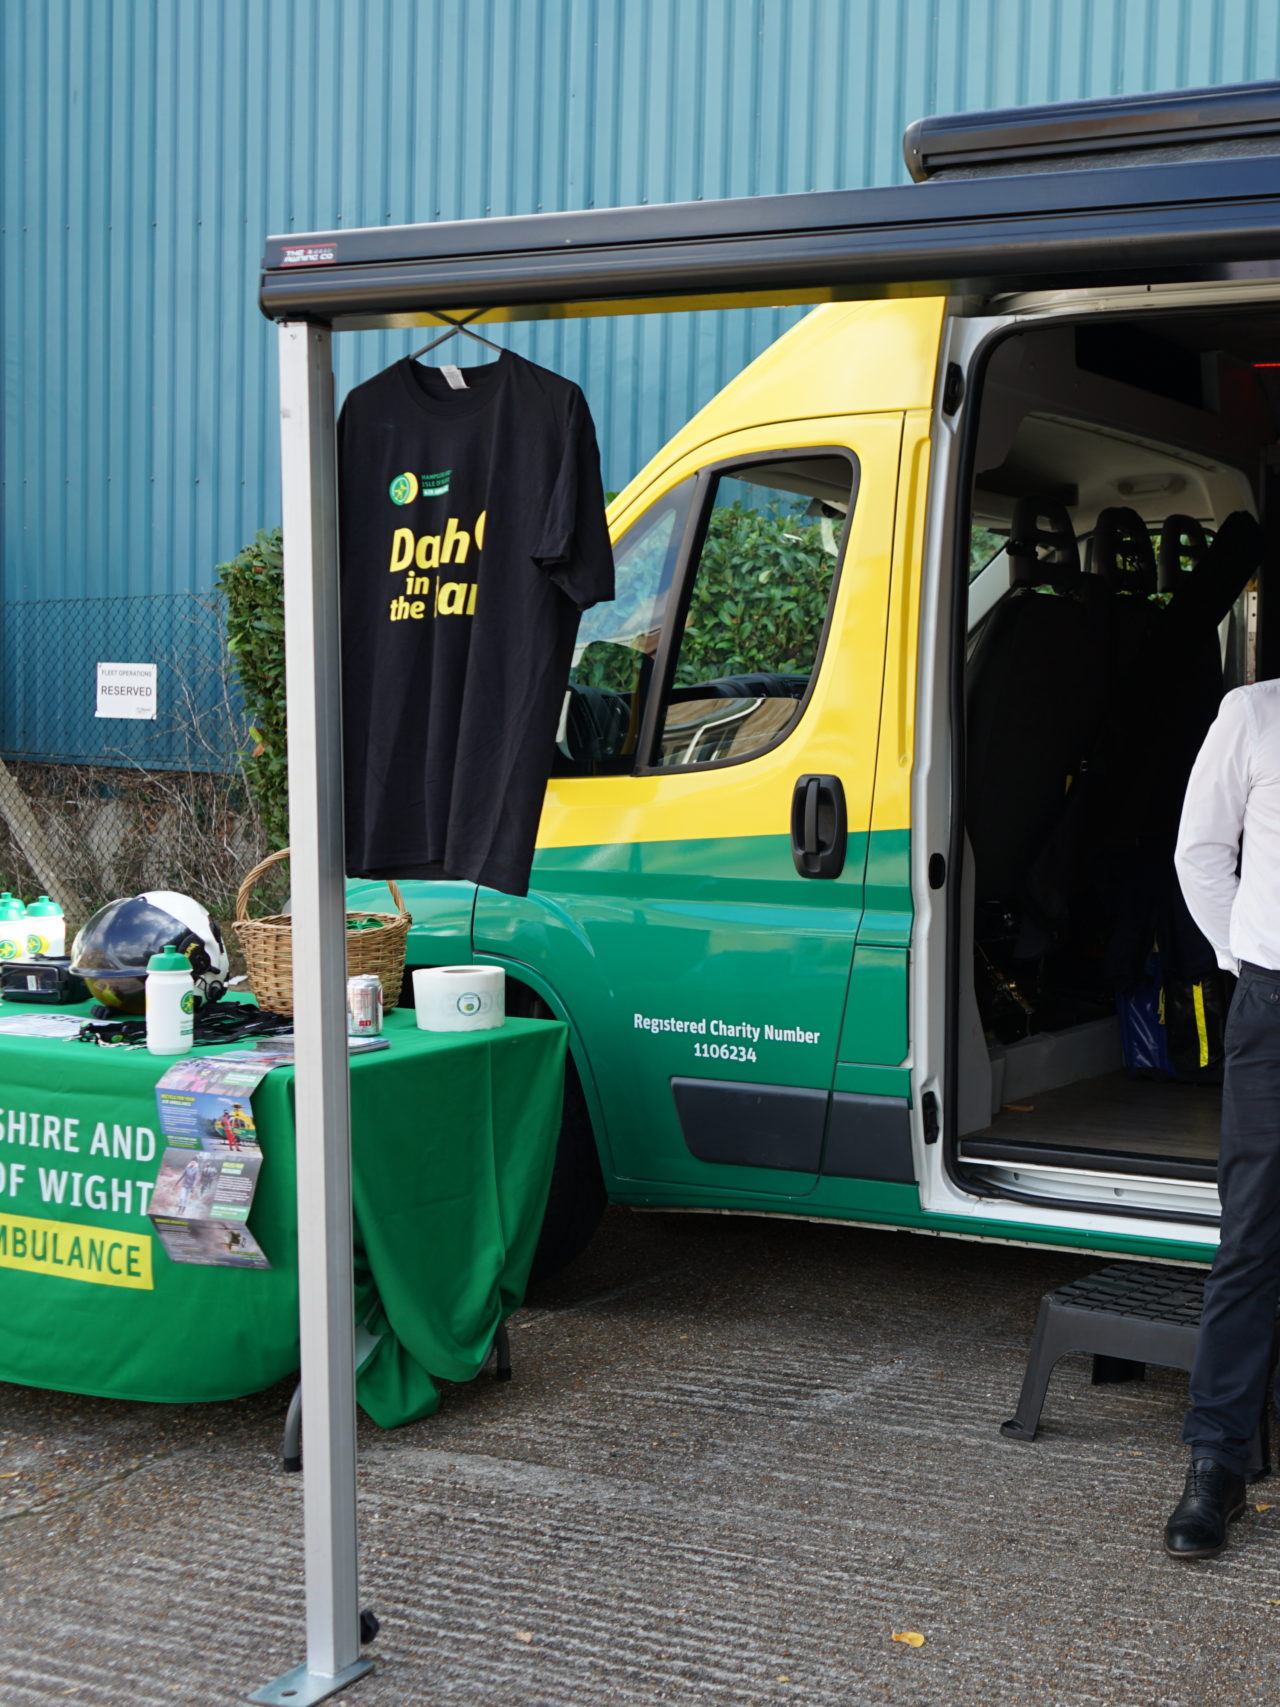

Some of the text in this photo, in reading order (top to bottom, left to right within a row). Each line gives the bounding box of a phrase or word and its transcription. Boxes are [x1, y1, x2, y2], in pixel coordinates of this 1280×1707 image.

[406, 570, 430, 595] in
[390, 595, 426, 622] the
[118, 670, 152, 678] OPERATIONS
[101, 685, 152, 697] RESERVED
[633, 1013, 821, 1044] Registered Charity Number
[693, 1043, 757, 1063] 1106234
[90, 1122, 156, 1162] AND
[38, 1167, 155, 1217] WIGHT
